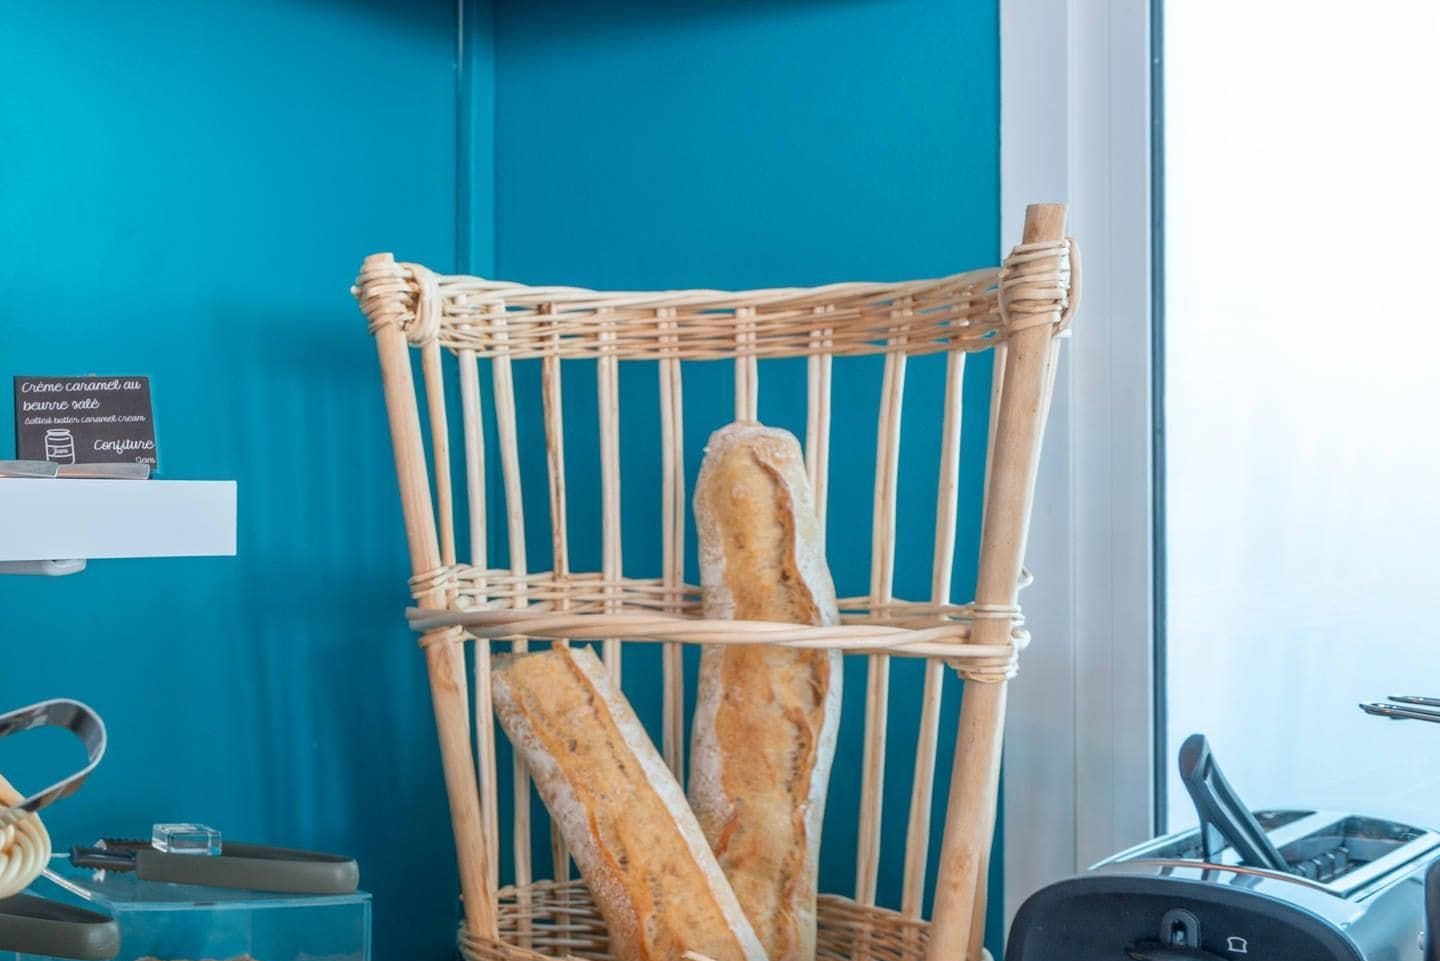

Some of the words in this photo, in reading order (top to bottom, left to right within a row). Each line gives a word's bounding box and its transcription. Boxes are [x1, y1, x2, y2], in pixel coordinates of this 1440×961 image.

[21, 381, 63, 393] Crème
[65, 379, 121, 392] caramel
[123, 380, 142, 390] au
[23, 400, 69, 411] beurre
[72, 398, 100, 409] salé
[93, 439, 155, 455] Confiture
